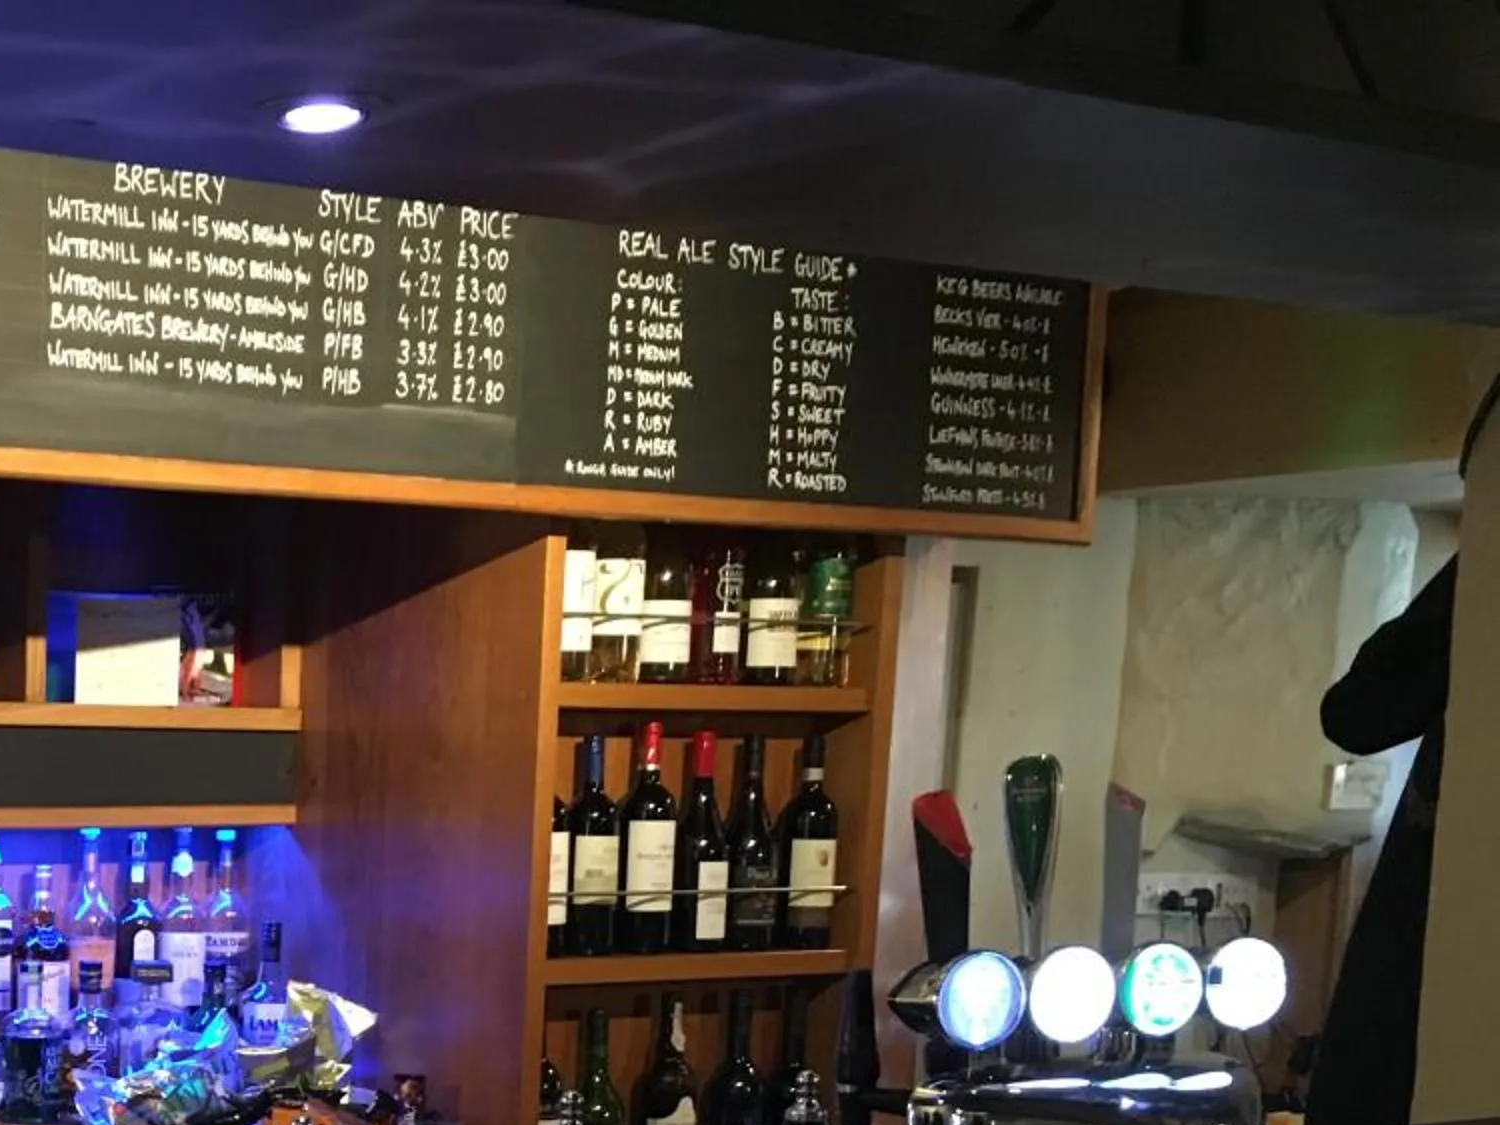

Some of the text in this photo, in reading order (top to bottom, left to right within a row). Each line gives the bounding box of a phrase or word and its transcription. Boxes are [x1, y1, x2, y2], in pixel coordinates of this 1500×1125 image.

[113, 162, 226, 206] BREWERY
[47, 194, 145, 229] WATERMILL
[317, 188, 520, 240] STYLE ABV PRICE
[47, 231, 141, 265] WATERMILL
[319, 228, 376, 259] G/CFD
[618, 229, 845, 283] REAL ALE STYLE GUIDE
[49, 267, 139, 302] WATERMILL
[323, 261, 370, 294] G/HD
[49, 301, 156, 340] BARNGATES
[322, 296, 367, 330] G/HB
[640, 296, 682, 319] PALE
[637, 321, 684, 342] GOLDEN
[802, 314, 857, 338] BITTER
[47, 338, 124, 372] WATERMILL
[323, 331, 364, 361] P/FB
[800, 337, 853, 367] CREAMY
[321, 365, 362, 397] P/HB
[801, 361, 832, 382] DRY
[635, 391, 676, 411] DARK
[797, 406, 847, 426] SWEET
[635, 413, 674, 435] RUBY
[796, 450, 838, 473] MALTY
[793, 472, 848, 493] ROASTED
